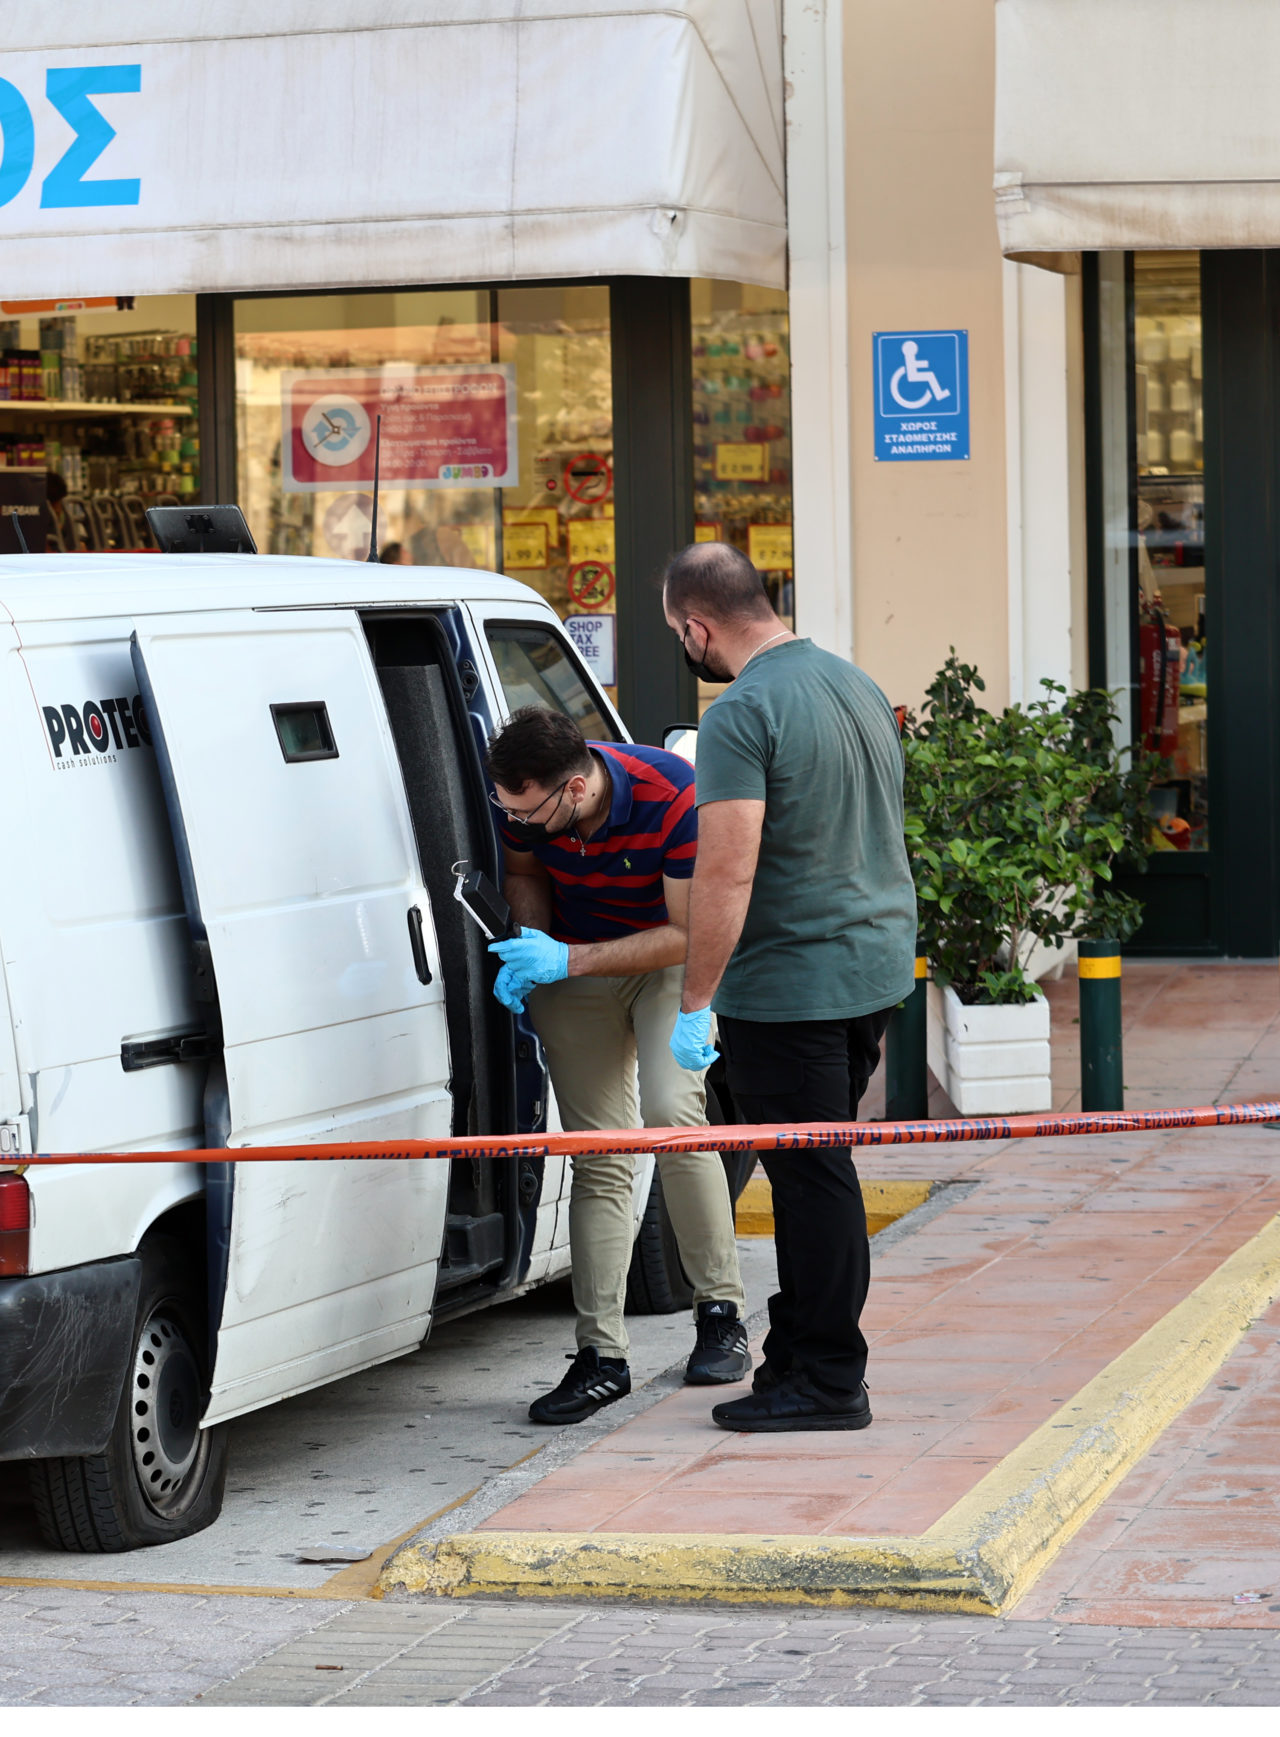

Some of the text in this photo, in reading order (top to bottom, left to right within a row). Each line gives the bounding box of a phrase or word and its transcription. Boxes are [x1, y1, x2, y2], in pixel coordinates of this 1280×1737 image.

[901, 421, 937, 431] ΧΩΡΟΣ
[884, 432, 957, 443] ΣΤΑΘΜΕΥΣΗΣ
[891, 444, 951, 454] ΑΝΑΠΗΡΩΝ
[569, 621, 603, 633] SHOP
[571, 634, 593, 645] TAX
[577, 646, 600, 657] REE
[57, 754, 118, 770] cash solutions
[893, 1119, 1011, 1144] ΑΣΤΥΝΟΜΙΑ
